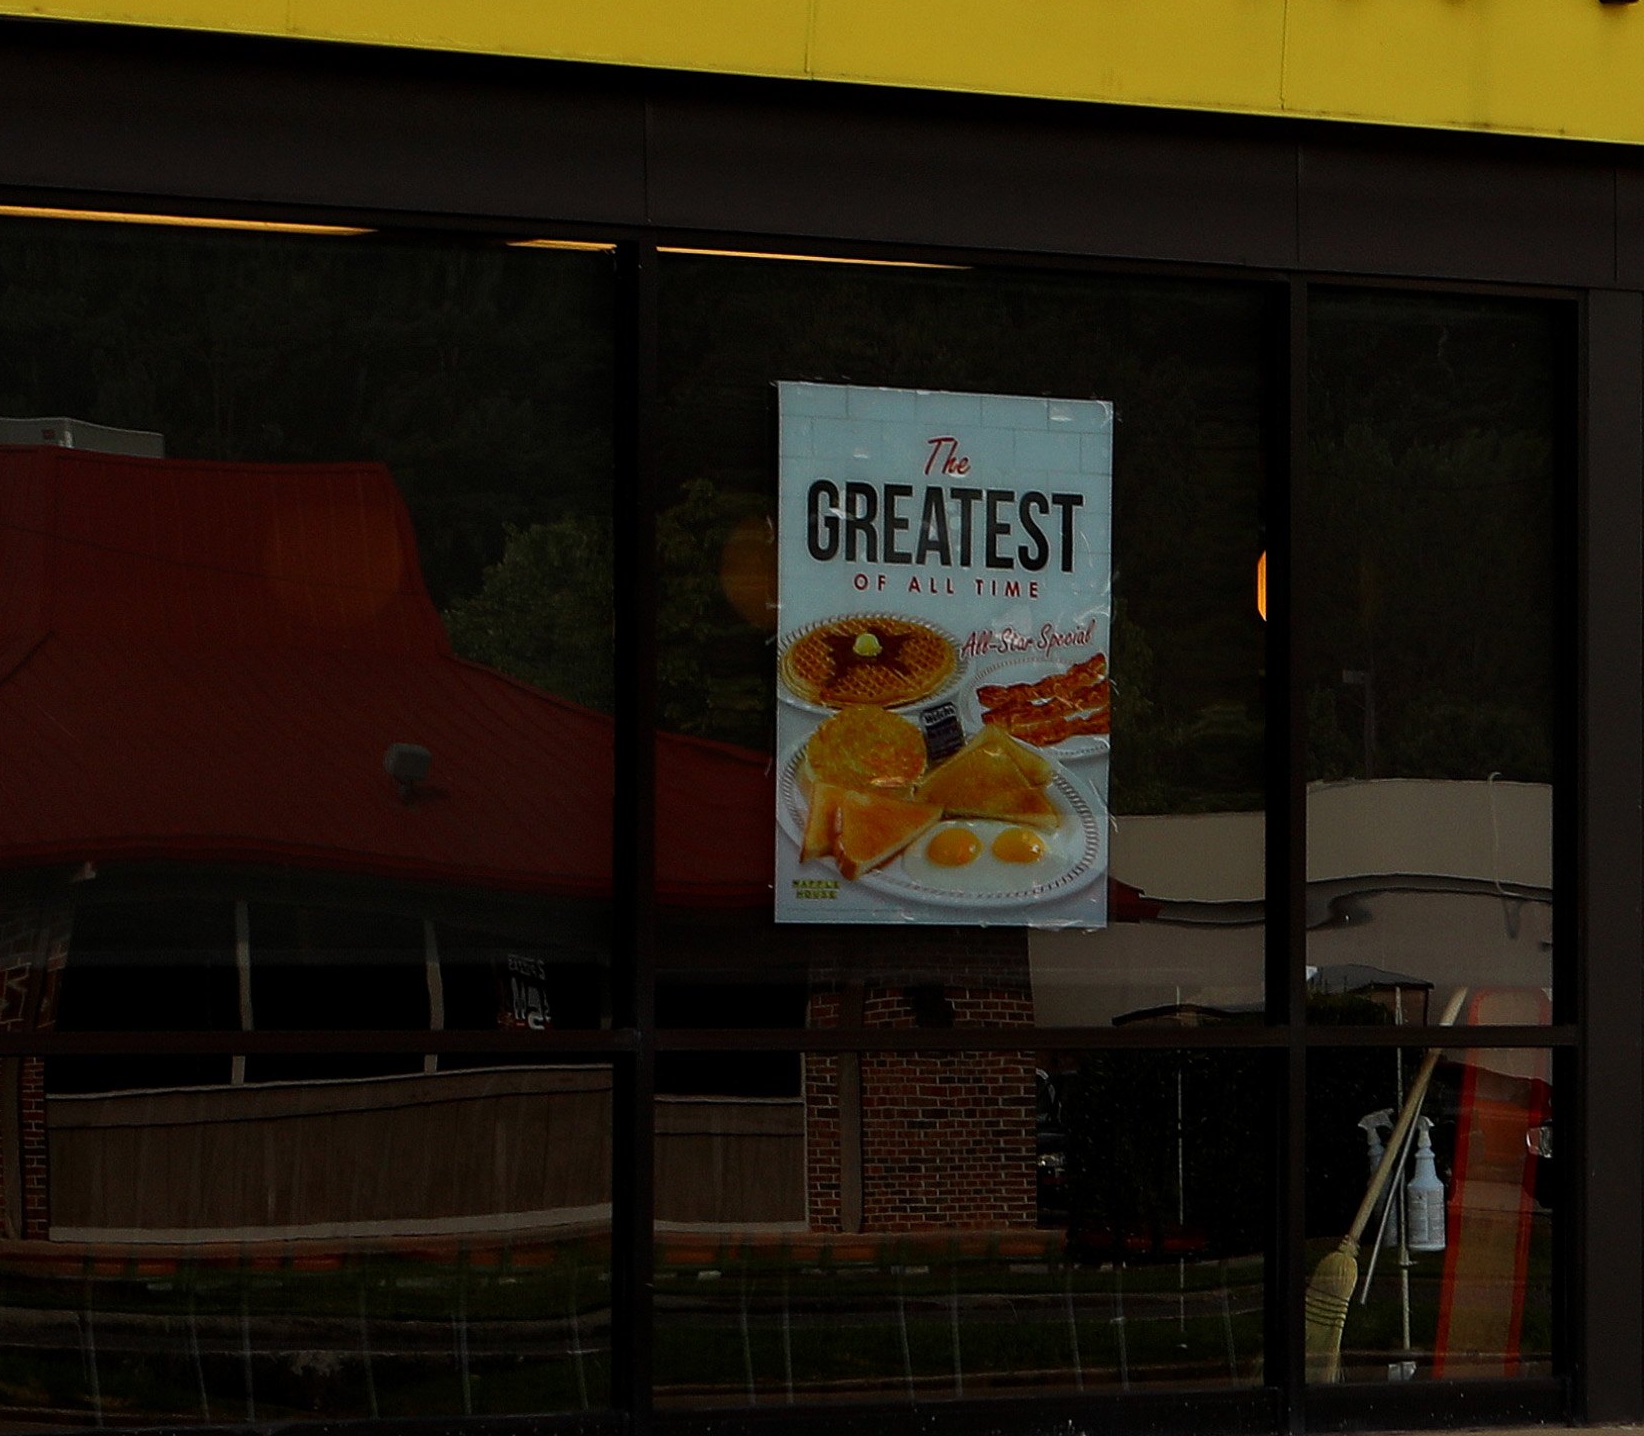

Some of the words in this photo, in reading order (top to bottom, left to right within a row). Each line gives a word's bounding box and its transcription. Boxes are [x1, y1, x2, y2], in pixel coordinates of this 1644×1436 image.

[924, 437, 970, 475] The
[806, 479, 1084, 573] GREATEST
[854, 573, 886, 591] OF
[908, 576, 954, 595] ALL
[975, 579, 1039, 598] TIME
[959, 627, 1035, 659] All-Star
[1037, 619, 1096, 658] Special
